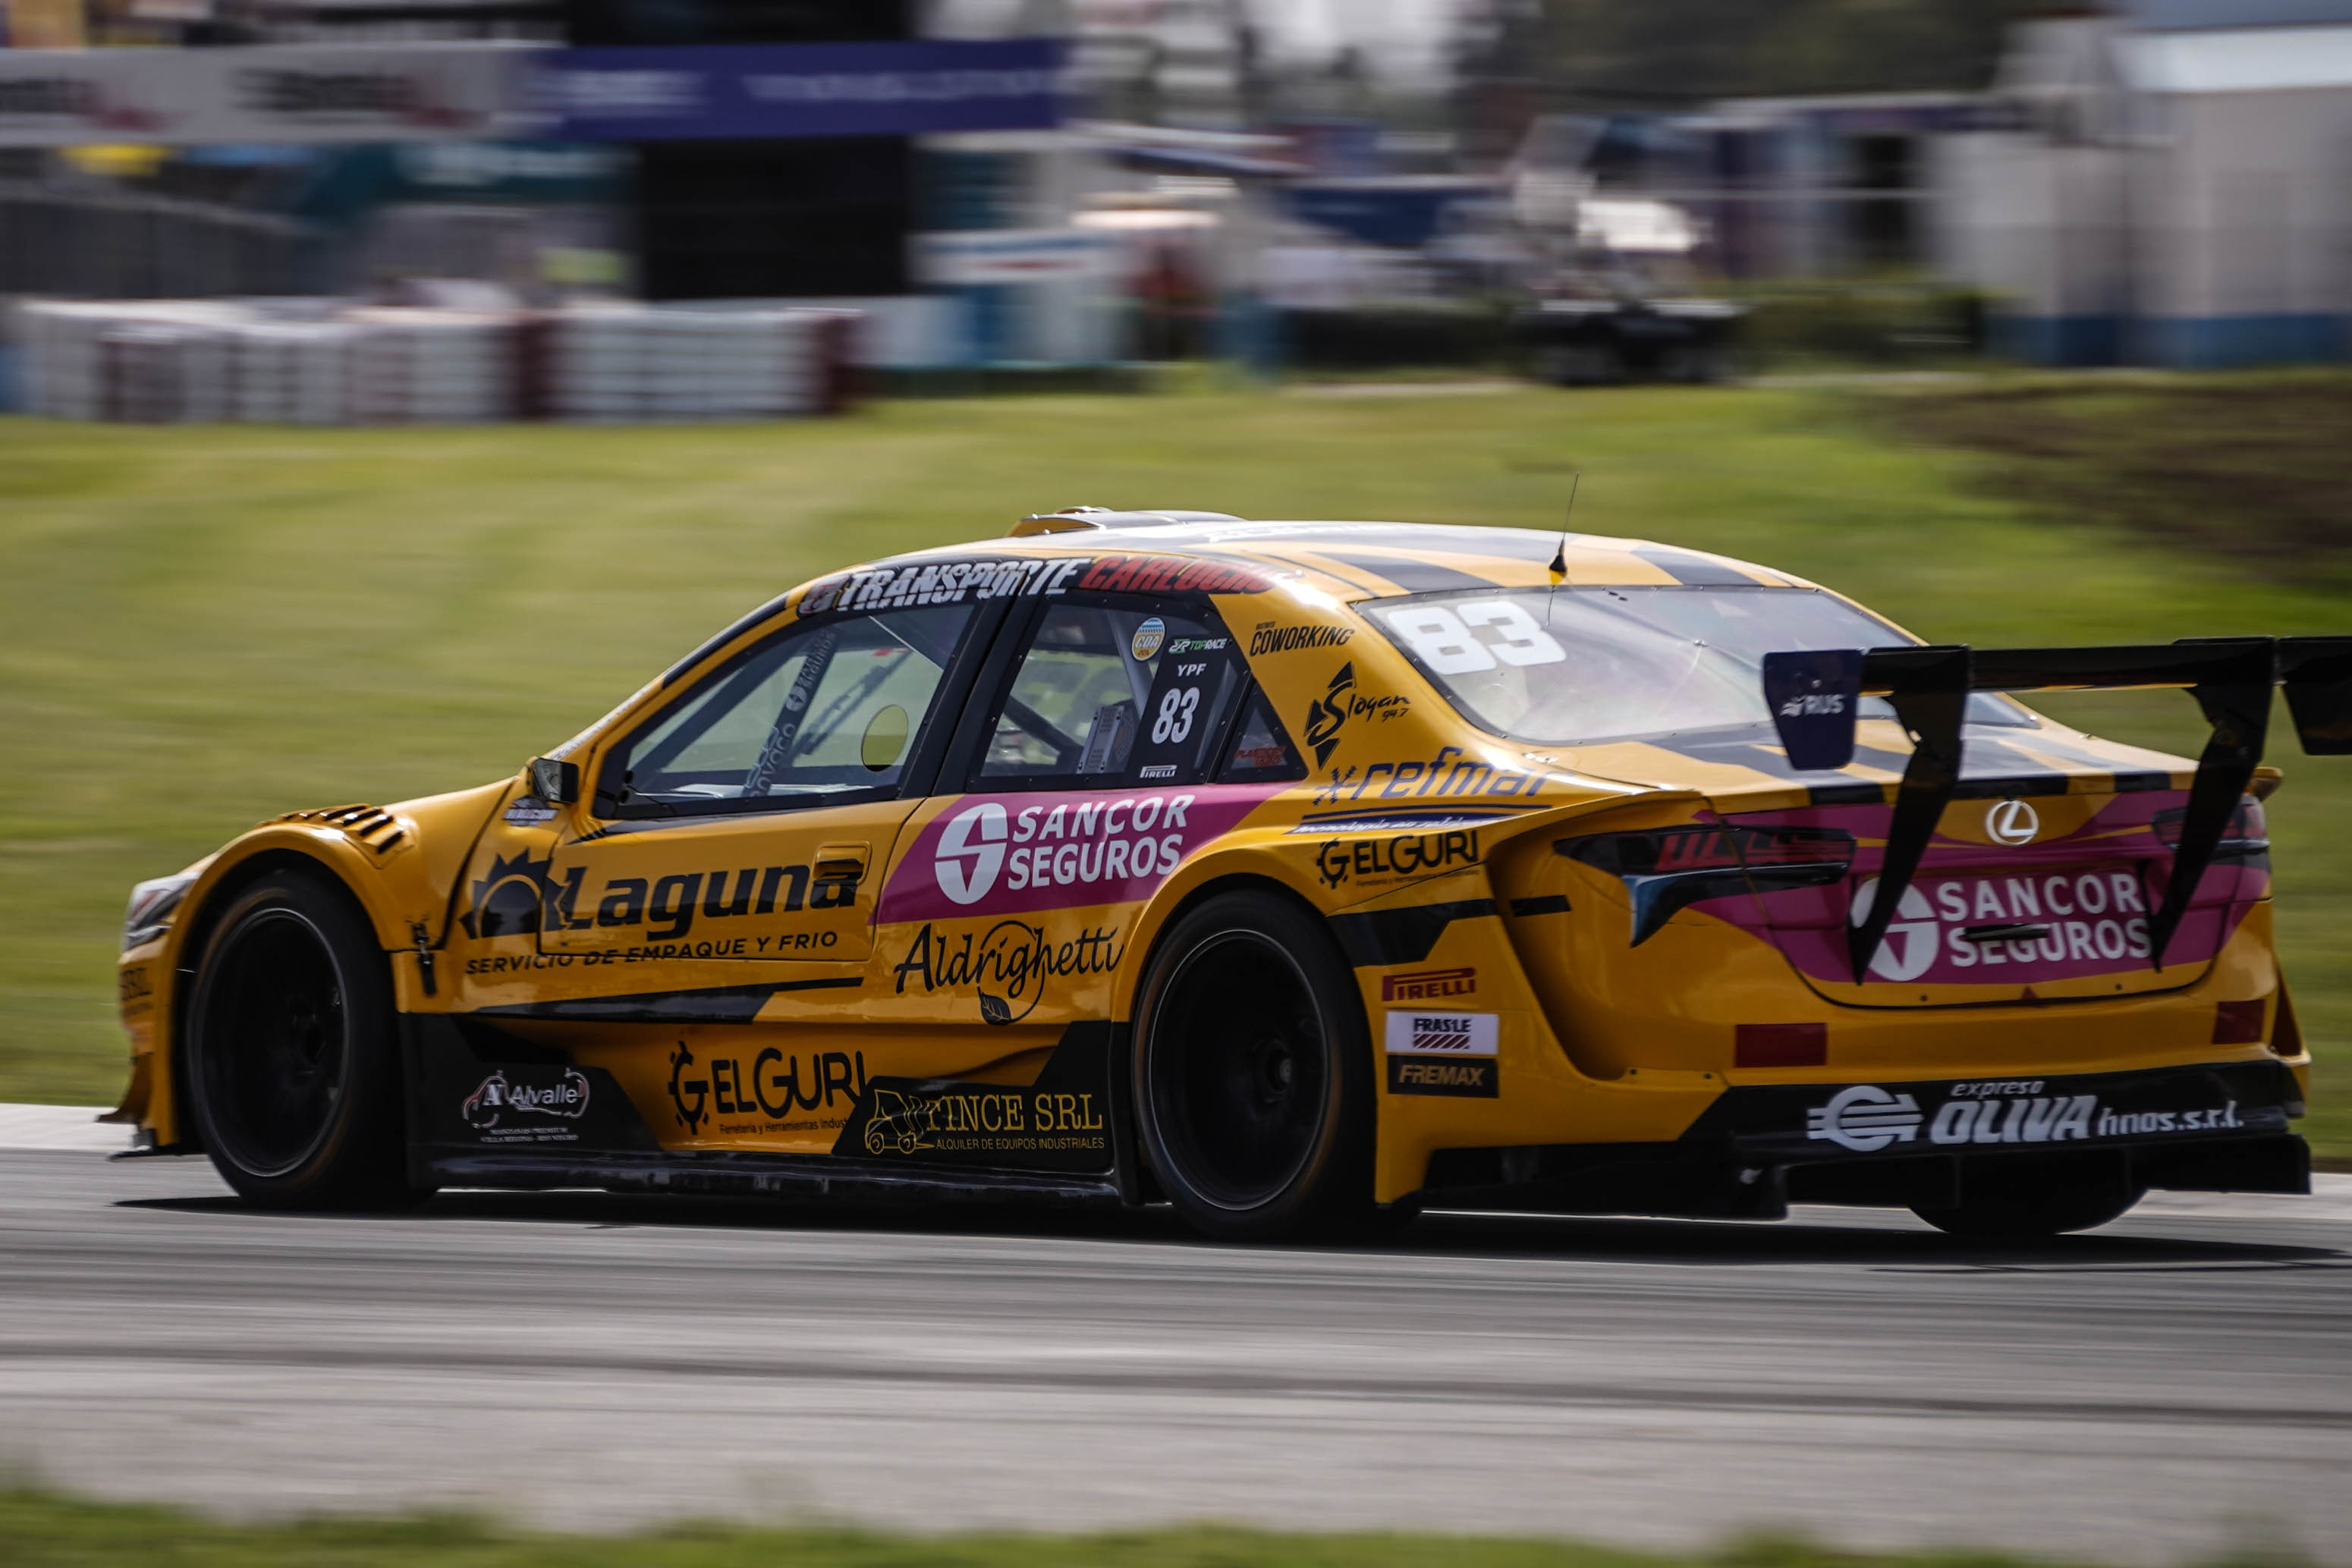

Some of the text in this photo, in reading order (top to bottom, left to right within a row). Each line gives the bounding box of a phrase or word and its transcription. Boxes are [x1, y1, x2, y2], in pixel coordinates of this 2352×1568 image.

[1250, 625, 1355, 657] COWORKING
[1388, 601, 1567, 676] 83
[1178, 662, 1207, 677] YPF
[1151, 686, 1200, 745] 83
[1306, 680, 1411, 747] Slogan
[1139, 765, 1178, 778] PIRELLI
[1011, 794, 1196, 843] SANCOR
[1008, 834, 1184, 891] SEGUROS
[1317, 830, 1479, 889] GELGURI
[561, 859, 860, 942] Laguna
[1936, 872, 2149, 922] SANCOR
[464, 931, 839, 975] SERVICIO DE EMPAQUE Y FRIO
[894, 922, 1126, 999] Aldrighetti
[1947, 918, 2154, 968] SEGUROS
[1382, 967, 1477, 1002] PIRELLI
[508, 1084, 578, 1105] Alvalle
[667, 1040, 867, 1136] GELGURI
[1398, 1064, 1486, 1087] FREMAX
[1952, 1080, 2046, 1101] expreso
[1036, 1093, 1103, 1132] SRL
[1930, 1095, 2098, 1145] OLIVA
[936, 1137, 1105, 1151] ALQUILER DE EQUIPOS INDUSTRIALES
